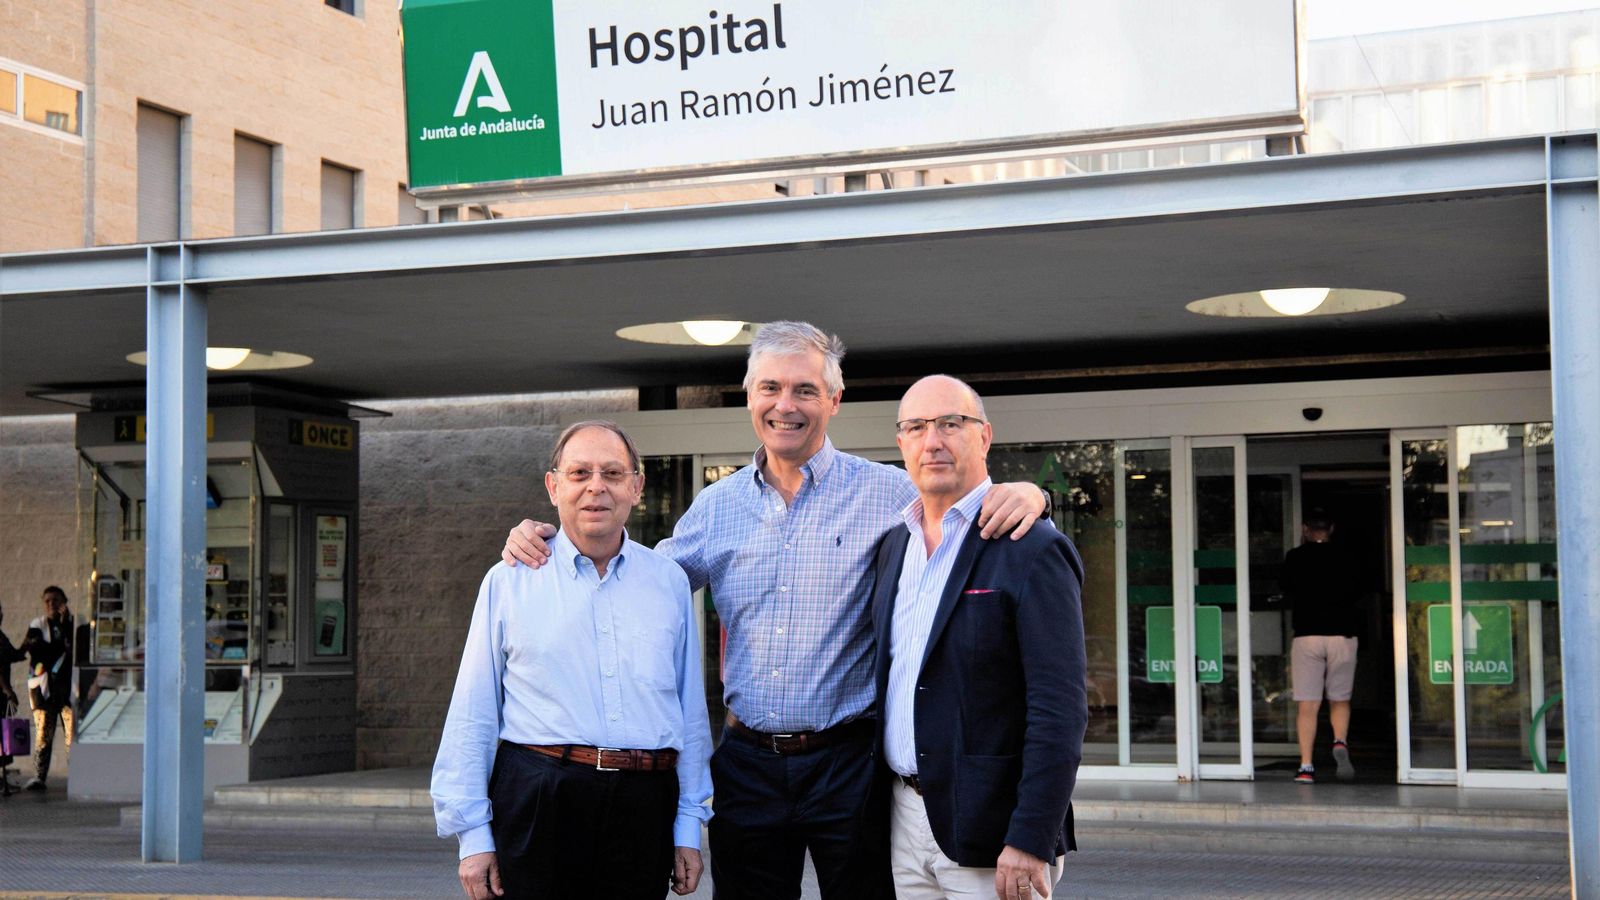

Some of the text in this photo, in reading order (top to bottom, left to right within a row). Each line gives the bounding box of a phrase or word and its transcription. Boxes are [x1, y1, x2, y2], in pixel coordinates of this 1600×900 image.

[588, 3, 787, 71] Hospital
[591, 63, 956, 129] Juan Ramón Jiménez
[420, 113, 546, 141] Junta de Andalucía
[307, 423, 349, 447] ONCE
[1151, 659, 1219, 673] ENTDA
[1433, 660, 1509, 673] ENRADA
